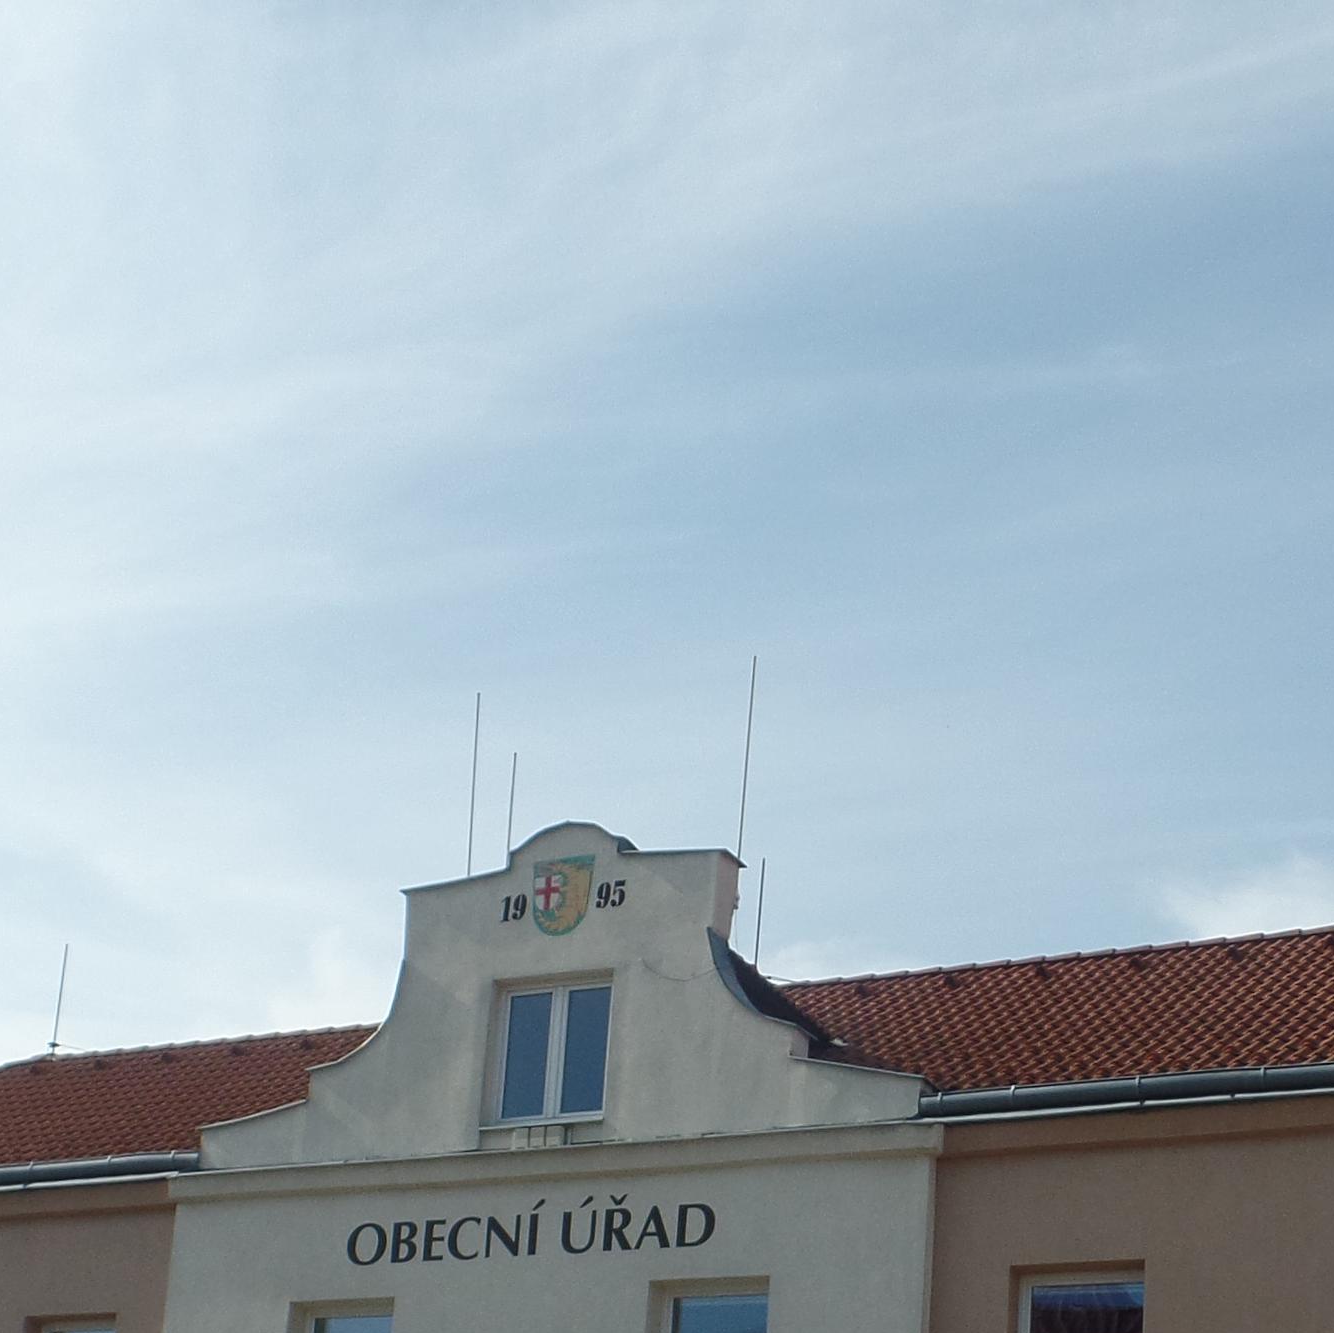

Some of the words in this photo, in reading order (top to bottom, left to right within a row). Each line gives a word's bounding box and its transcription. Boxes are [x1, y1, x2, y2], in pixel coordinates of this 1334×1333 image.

[501, 894, 527, 922] 19
[595, 879, 626, 908] 95
[346, 1198, 547, 1266] OBECNÍ
[560, 1193, 716, 1255] ÚŘAD
